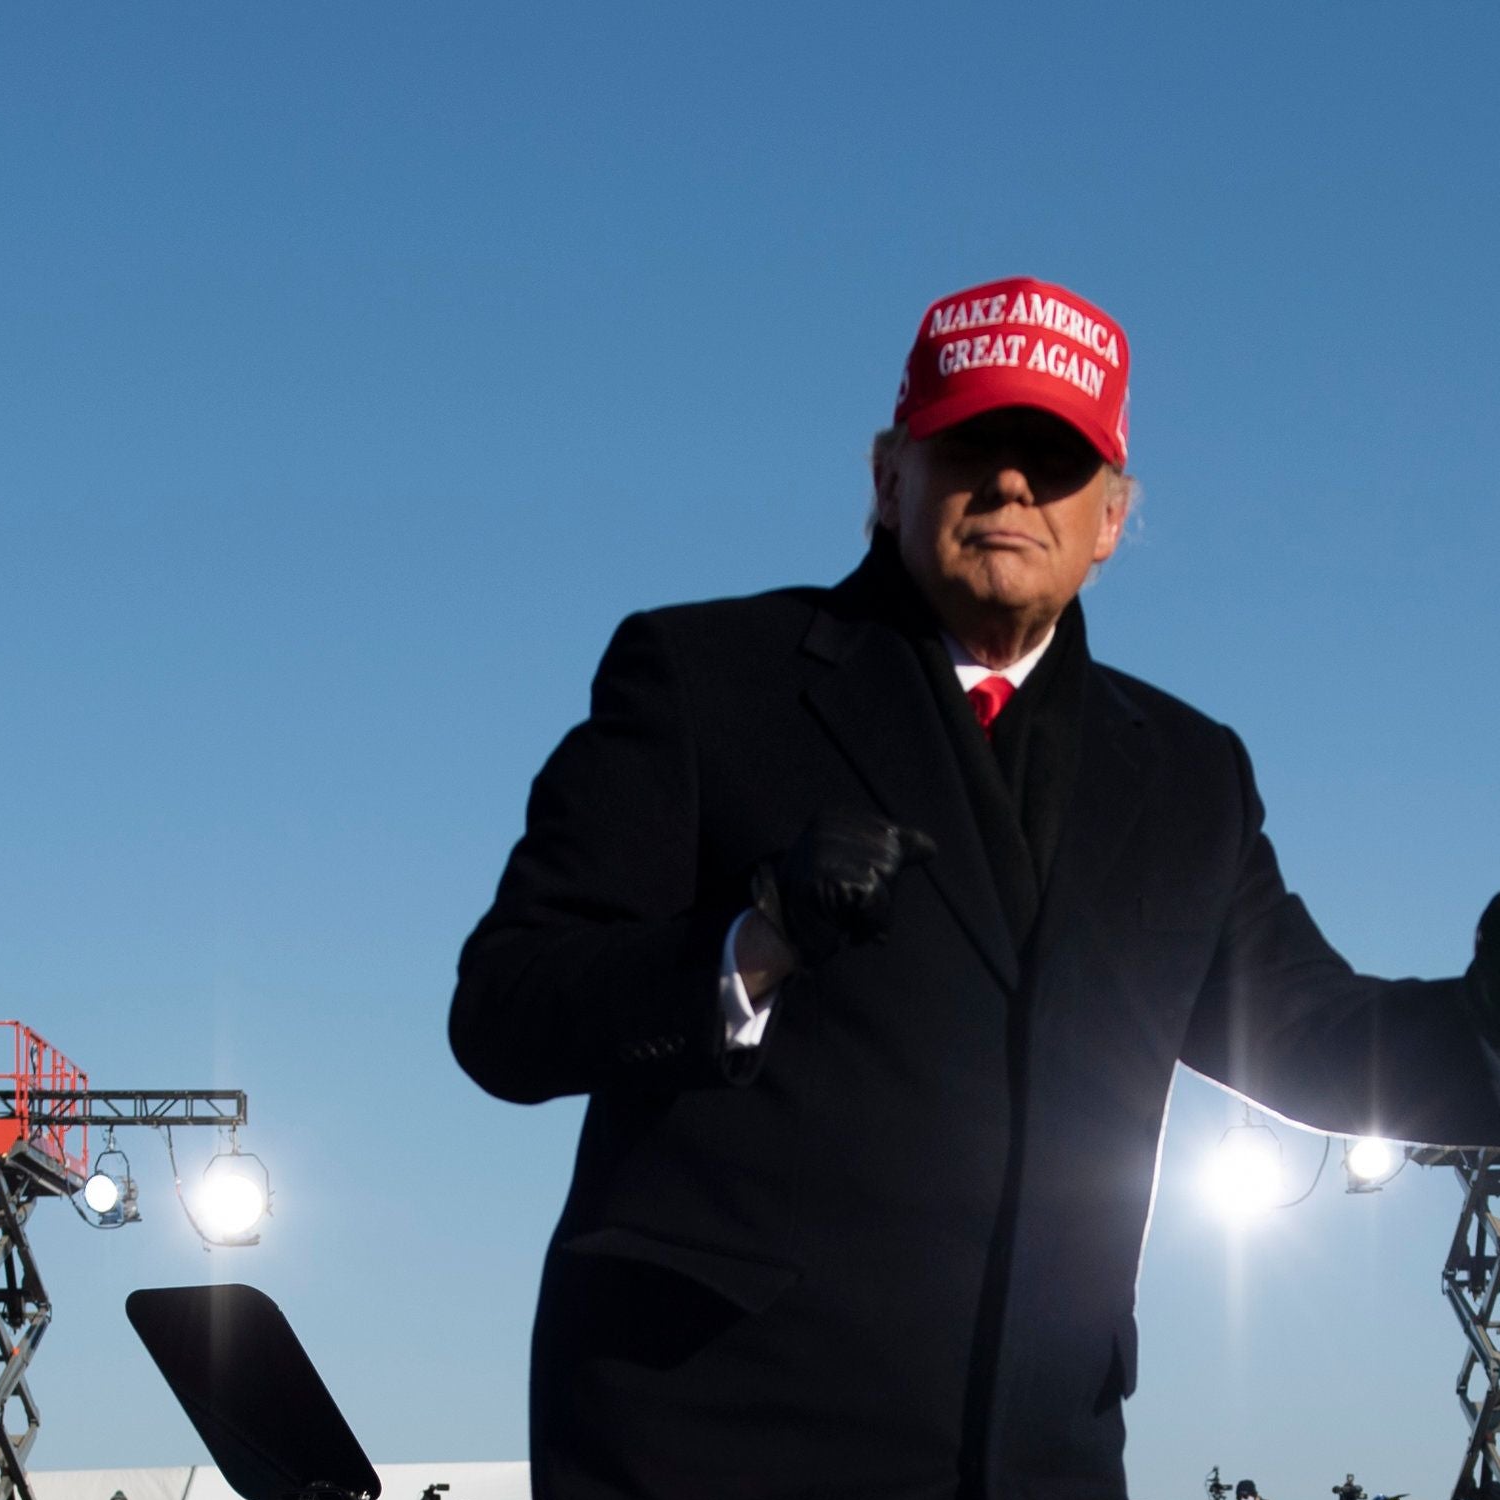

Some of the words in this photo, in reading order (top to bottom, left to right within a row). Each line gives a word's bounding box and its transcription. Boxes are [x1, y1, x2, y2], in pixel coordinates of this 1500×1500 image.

[928, 294, 1007, 338] MAKE
[1007, 291, 1120, 369] AMERICA
[938, 333, 1026, 377] GREAT
[1027, 338, 1107, 401] AGAIN
